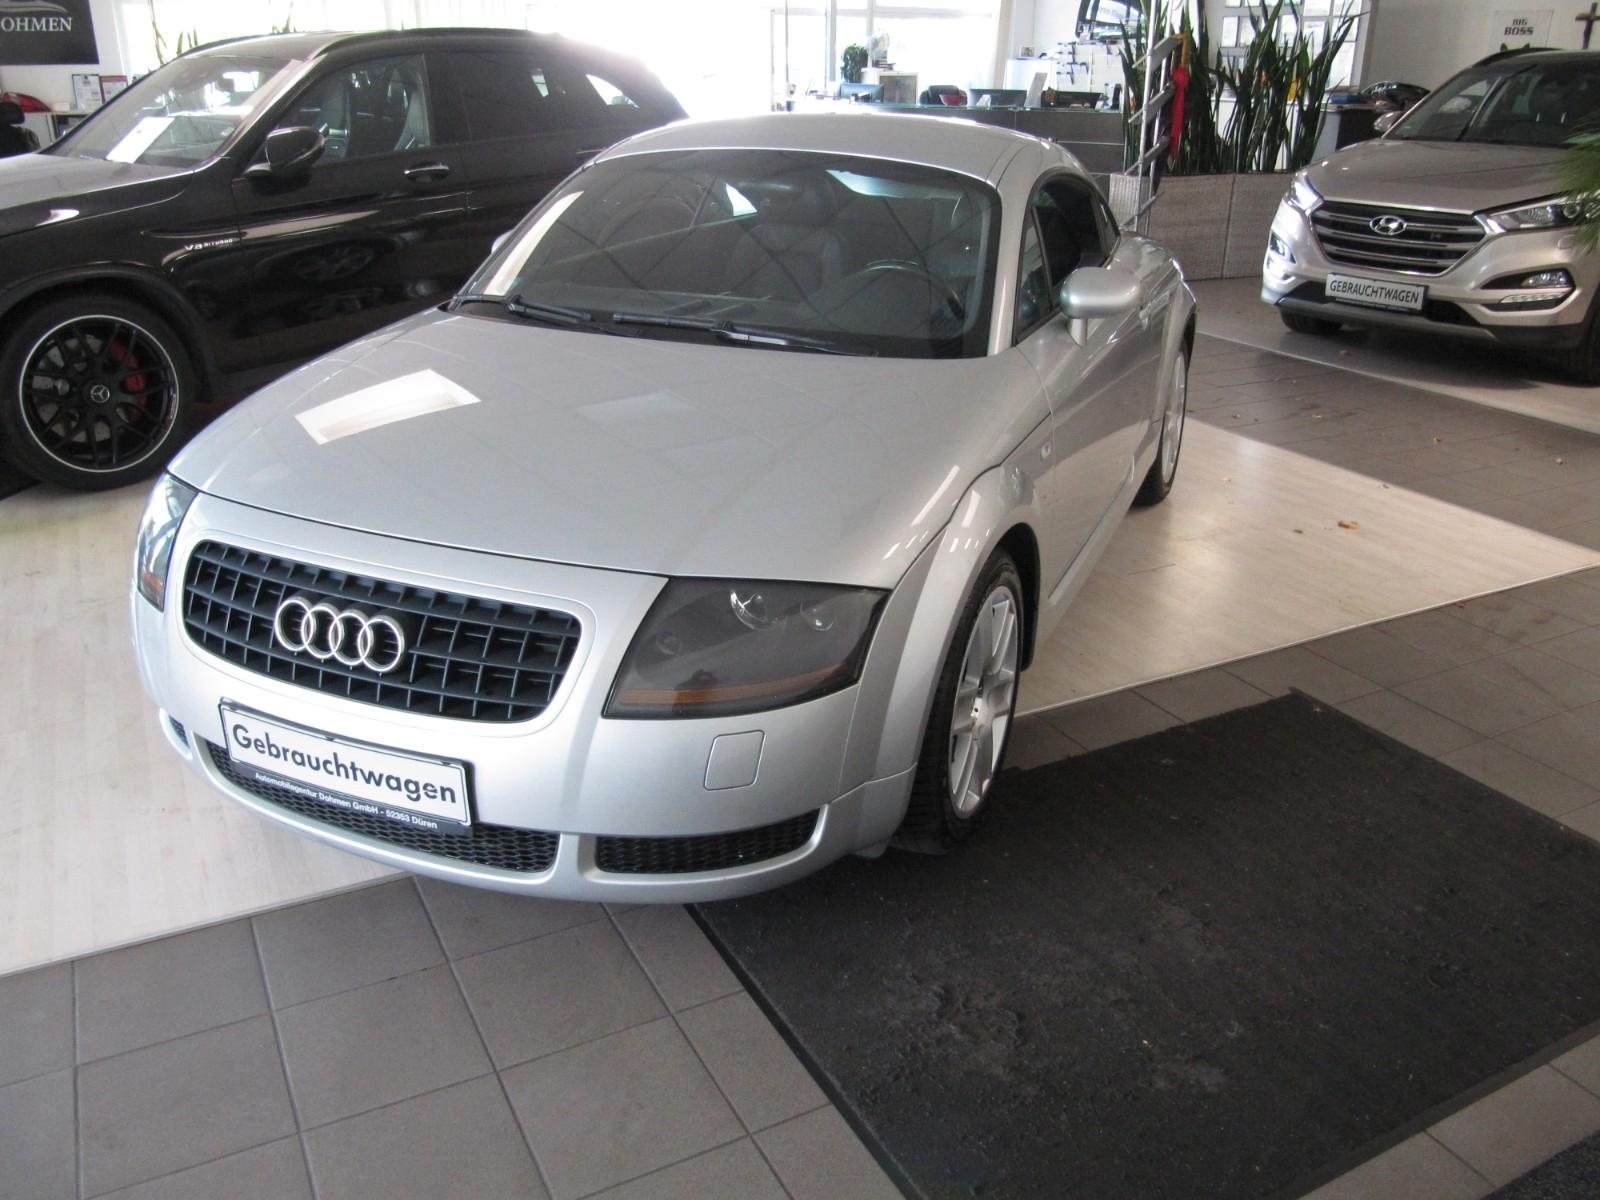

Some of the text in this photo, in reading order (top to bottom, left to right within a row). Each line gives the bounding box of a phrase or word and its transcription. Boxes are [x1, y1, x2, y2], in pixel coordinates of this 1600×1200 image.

[1504, 27, 1534, 36] BOSS
[1329, 280, 1419, 303] GEBRAUCHTWAGEN
[232, 723, 457, 803] Gebrauchtwagen
[318, 791, 351, 808] Dohmen
[352, 801, 379, 815] GmbH
[411, 815, 438, 830] Düren
